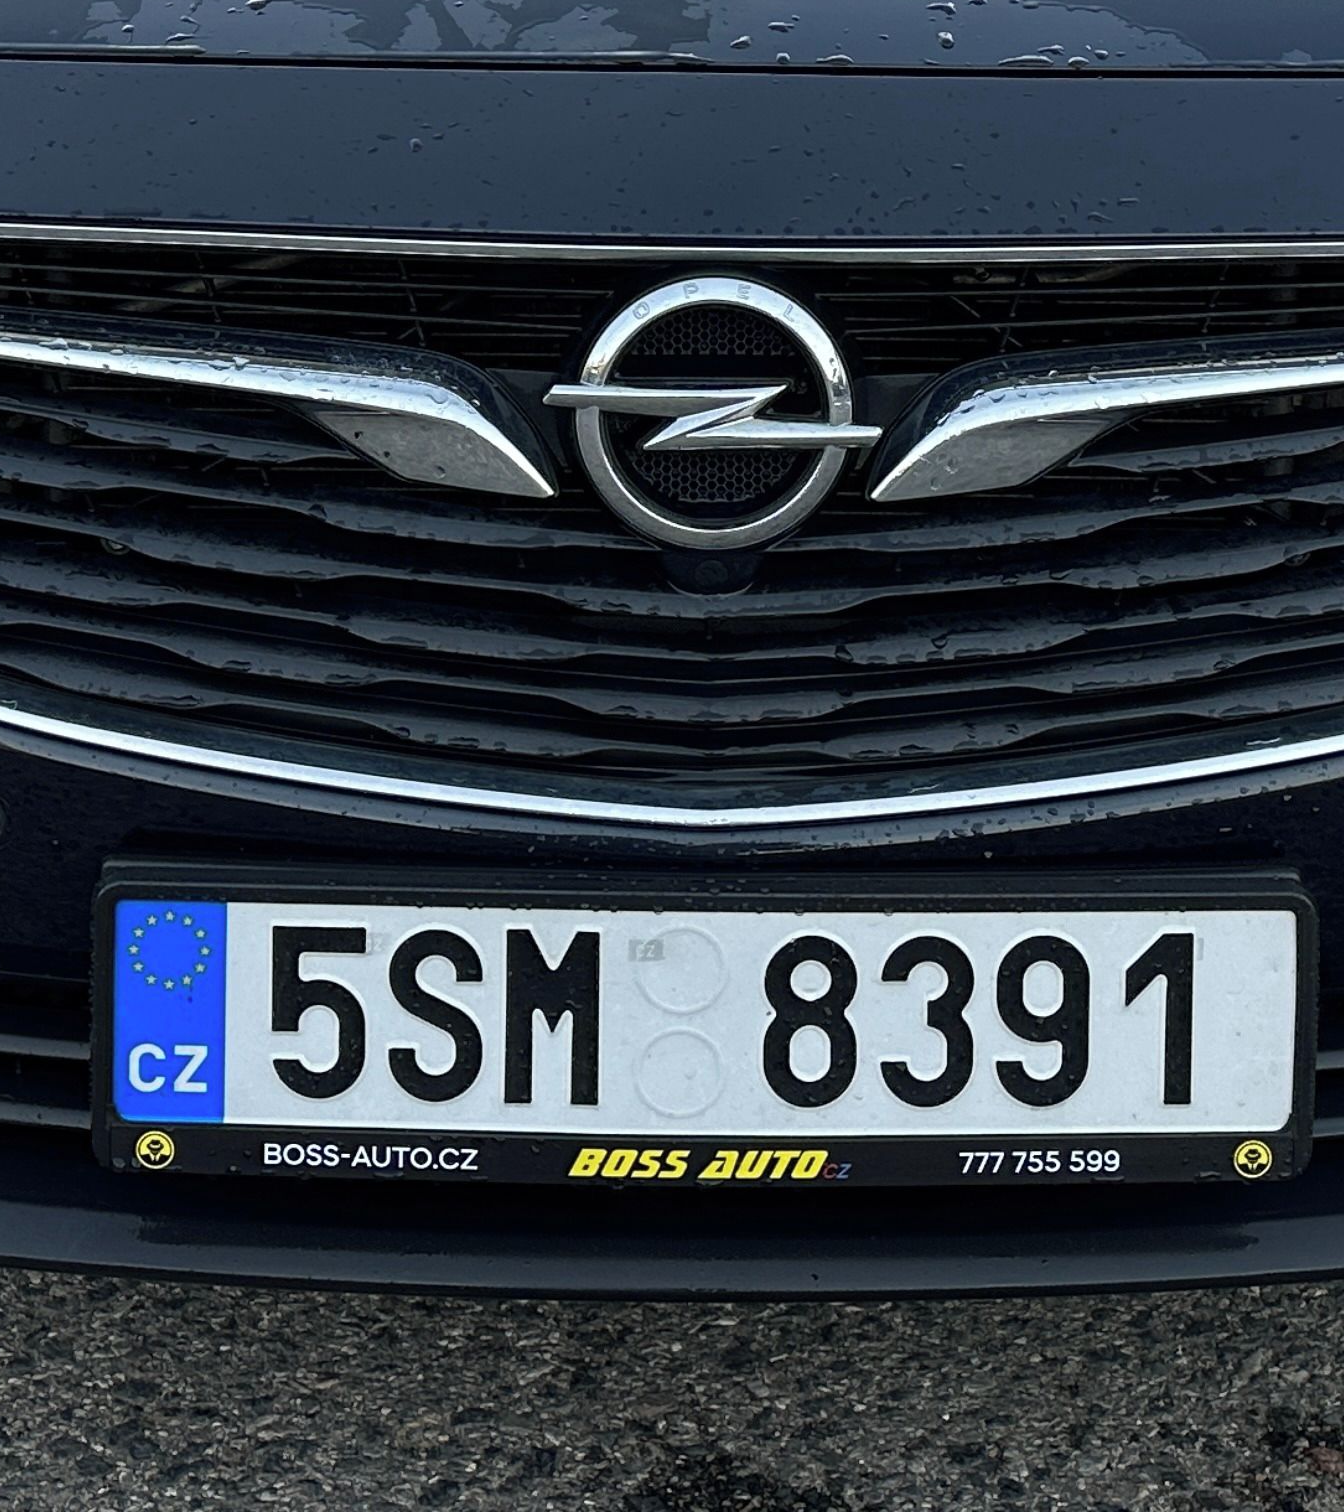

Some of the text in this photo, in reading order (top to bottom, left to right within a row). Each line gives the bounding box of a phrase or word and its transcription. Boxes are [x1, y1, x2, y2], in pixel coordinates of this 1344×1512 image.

[632, 282, 795, 322] OPEL
[271, 925, 1194, 1108] 5SM 8391
[128, 1043, 208, 1093] CZ
[263, 1142, 479, 1171] BOSS-AUTO.CZ
[567, 1148, 691, 1179] BOSS
[697, 1150, 829, 1179] AUTO
[958, 1149, 1120, 1174] 777 755 599
